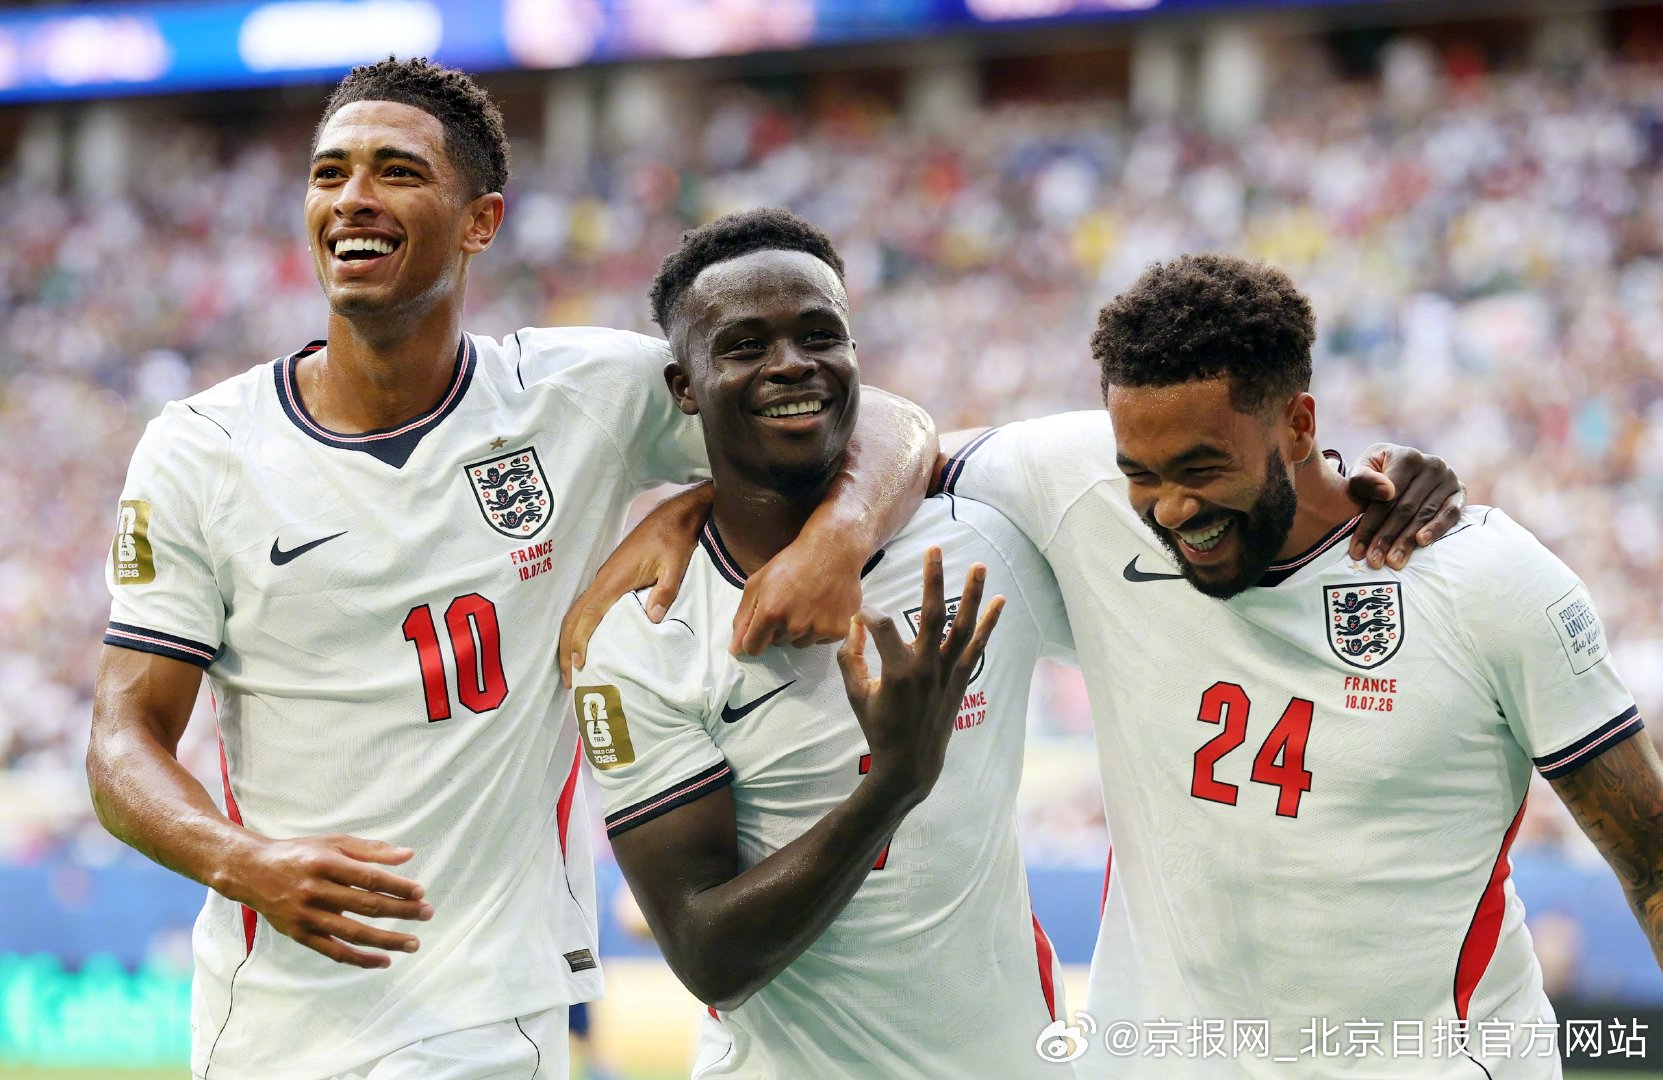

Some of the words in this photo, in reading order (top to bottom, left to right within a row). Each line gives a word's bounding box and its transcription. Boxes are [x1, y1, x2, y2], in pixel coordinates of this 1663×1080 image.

[510, 539, 553, 565] FRANCE
[119, 569, 140, 578] 026
[518, 556, 553, 582] 18.07.26
[1564, 606, 1595, 639] UNITES
[402, 592, 509, 723] 10
[1343, 676, 1397, 693] FRANCE
[960, 691, 987, 711] ANCE
[1345, 694, 1393, 712] 18.07.26
[1190, 680, 1315, 819] 24
